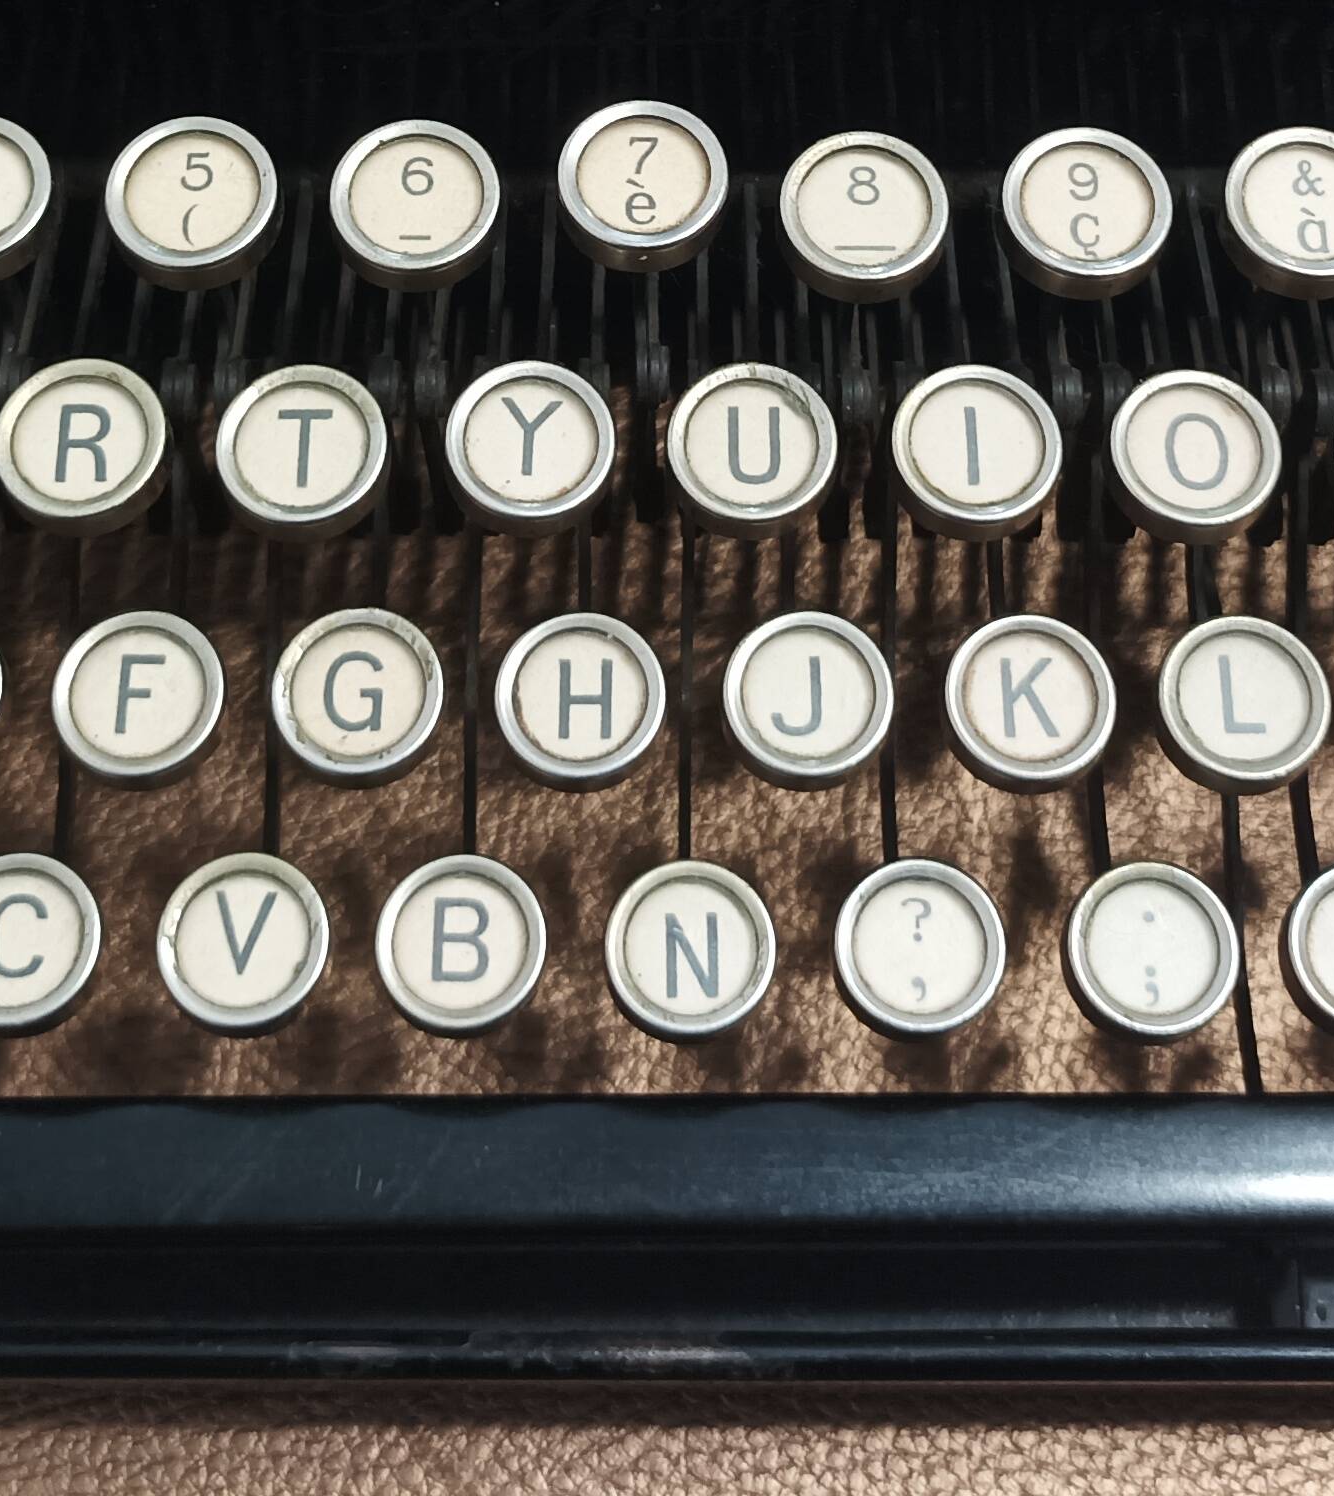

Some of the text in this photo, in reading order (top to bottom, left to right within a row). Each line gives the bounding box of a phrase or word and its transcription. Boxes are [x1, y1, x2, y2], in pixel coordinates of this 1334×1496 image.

[181, 152, 213, 191] 5
[402, 157, 434, 195] 6
[629, 137, 658, 174] 7
[847, 166, 880, 205] 8
[1068, 163, 1098, 201] 9
[1293, 160, 1325, 196] &
[182, 205, 196, 244] (
[625, 179, 656, 225] è
[1298, 208, 1329, 253] à
[55, 404, 110, 482] R
[278, 409, 333, 487] T
[500, 396, 561, 476] Y
[728, 406, 781, 484] U
[964, 407, 980, 485] I
[1165, 413, 1228, 490] O
[115, 655, 166, 734] F
[323, 651, 383, 732] G
[559, 659, 612, 739] H
[771, 656, 822, 736] J
[1000, 657, 1059, 738] K
[1218, 655, 1266, 734] L
[216, 891, 277, 975] V
[432, 898, 489, 982] B
[665, 913, 718, 998] N
[901, 897, 931, 942] ?
